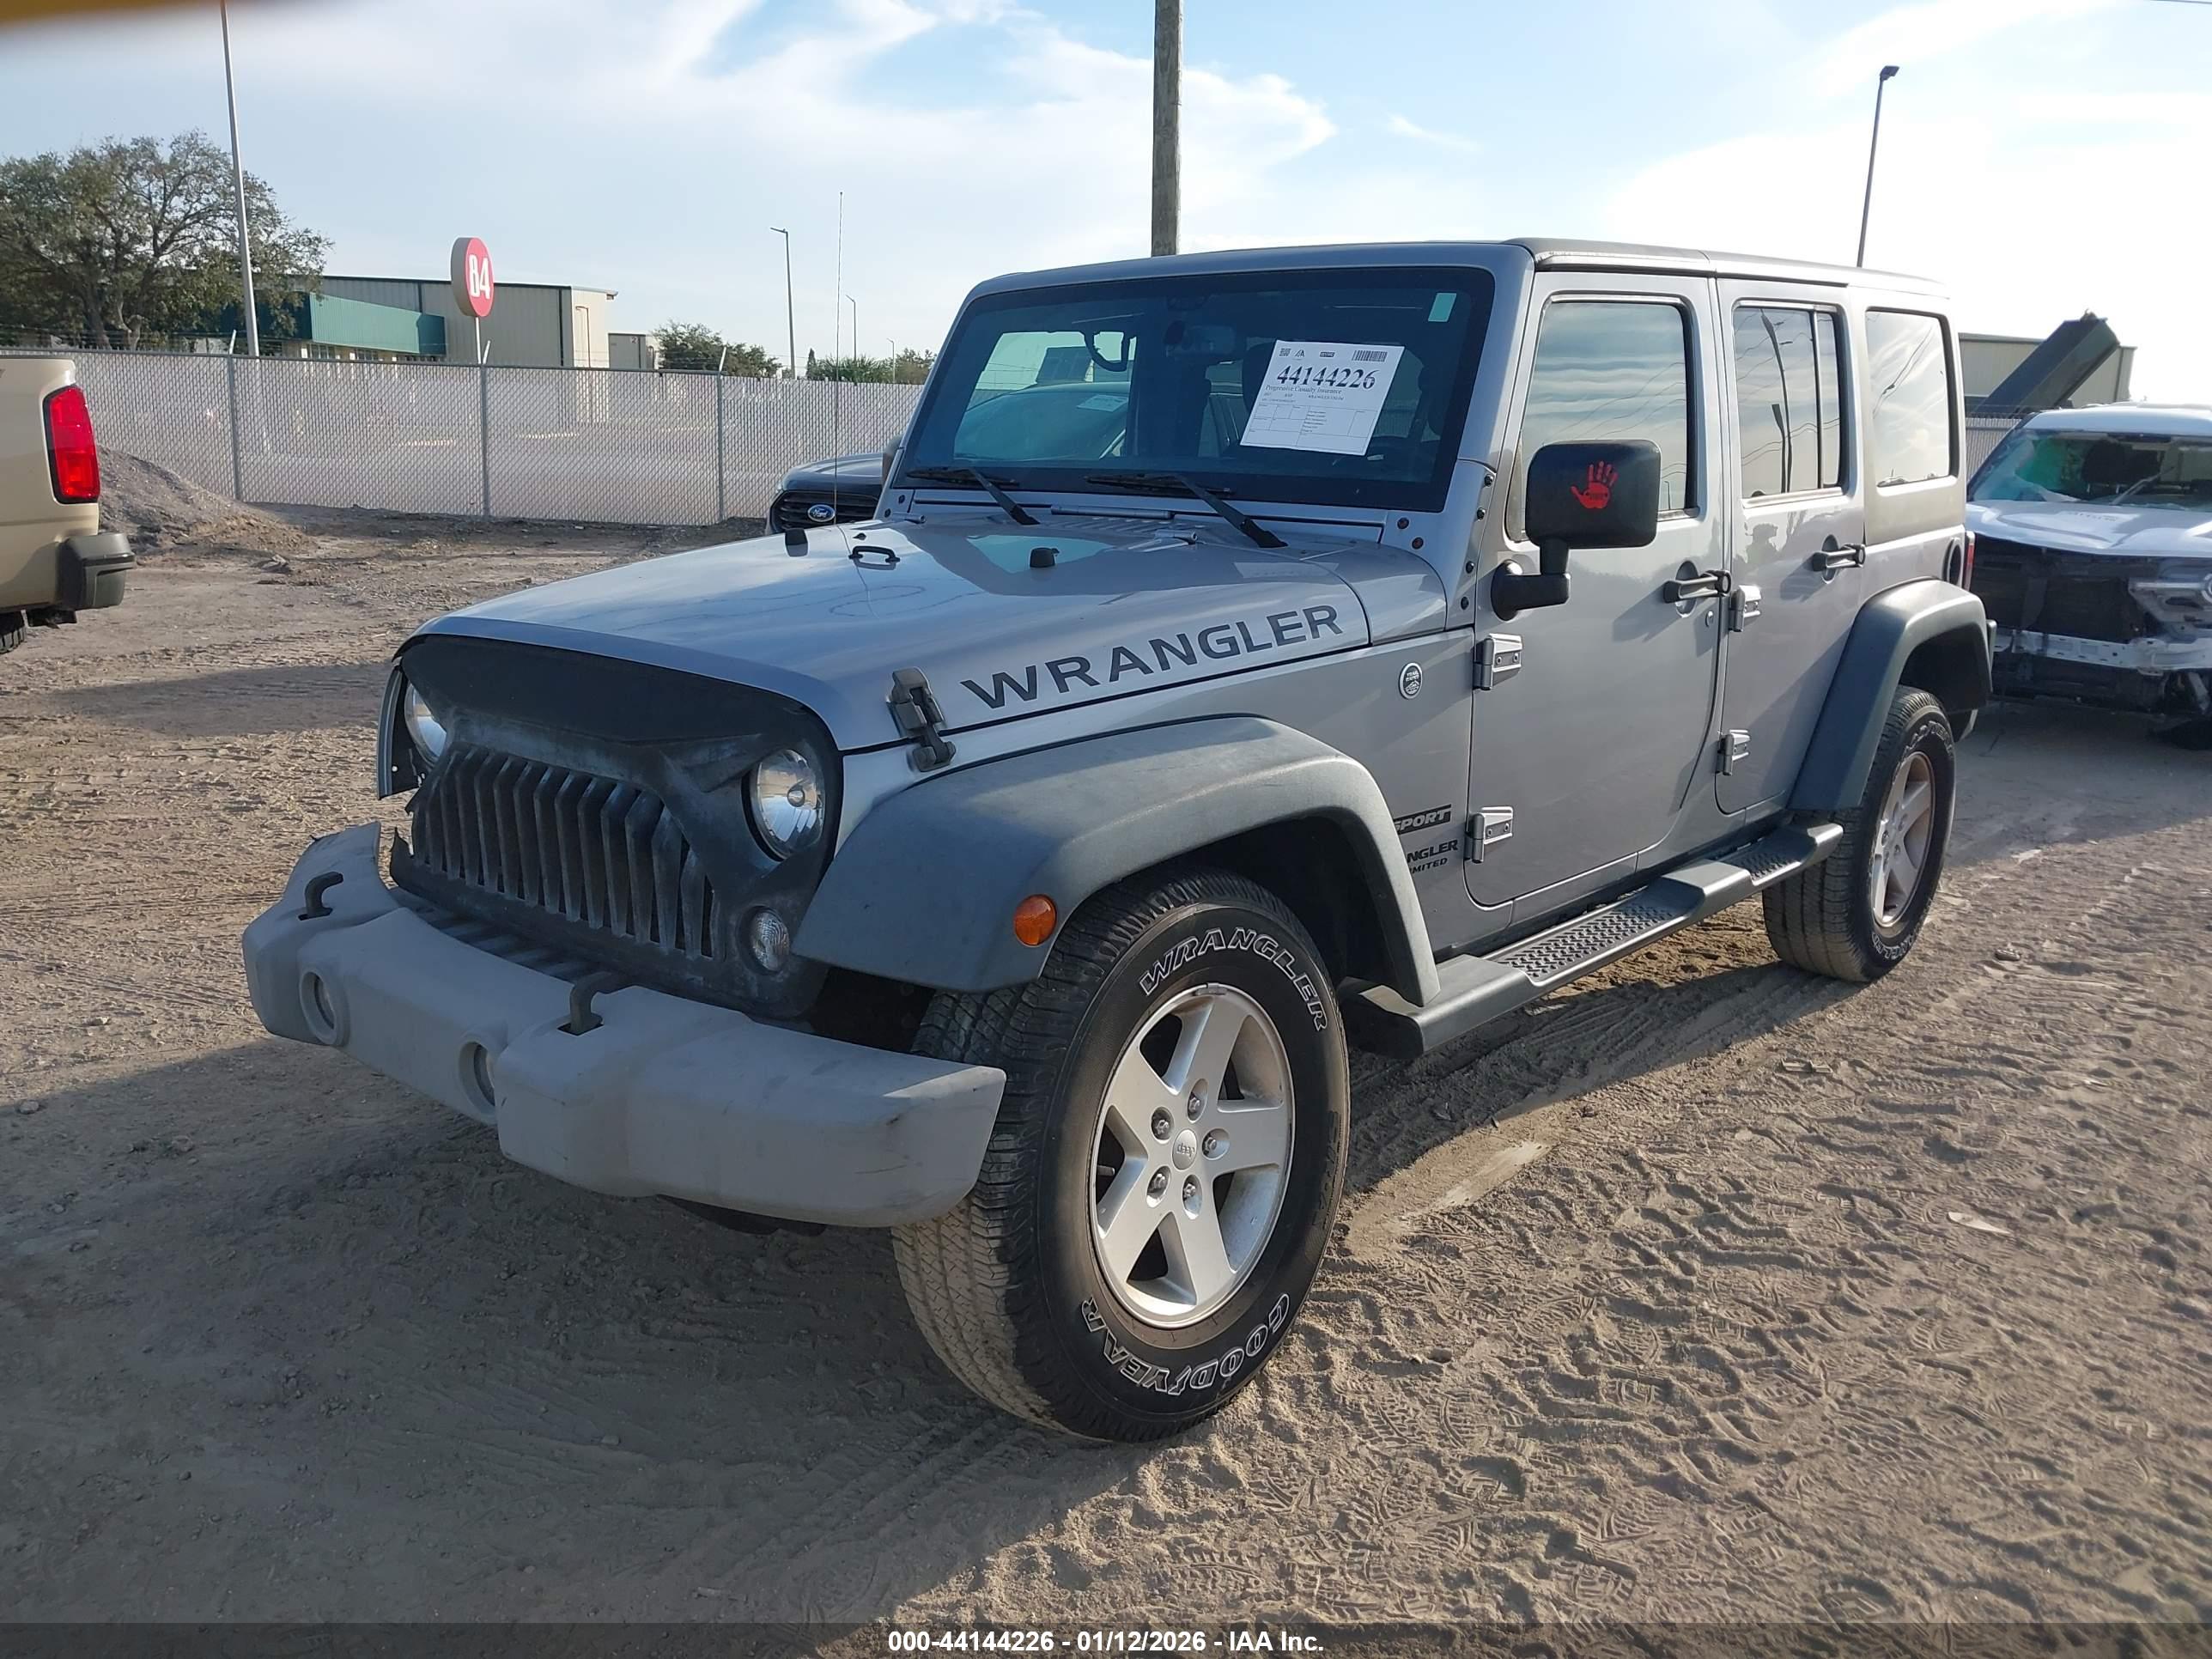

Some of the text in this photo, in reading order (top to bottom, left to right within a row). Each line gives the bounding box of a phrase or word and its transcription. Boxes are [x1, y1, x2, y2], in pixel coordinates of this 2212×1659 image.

[469, 254, 490, 300] 84
[1277, 365, 1379, 389] 44144226
[960, 605, 1343, 709] WRANGLER
[1394, 808, 1451, 832] SPORT
[1407, 839, 1458, 863] NGLER
[1409, 857, 1448, 874] IMITED
[1139, 927, 1327, 1031] WRANGLER
[1081, 1293, 1291, 1395] GOODYEAR
